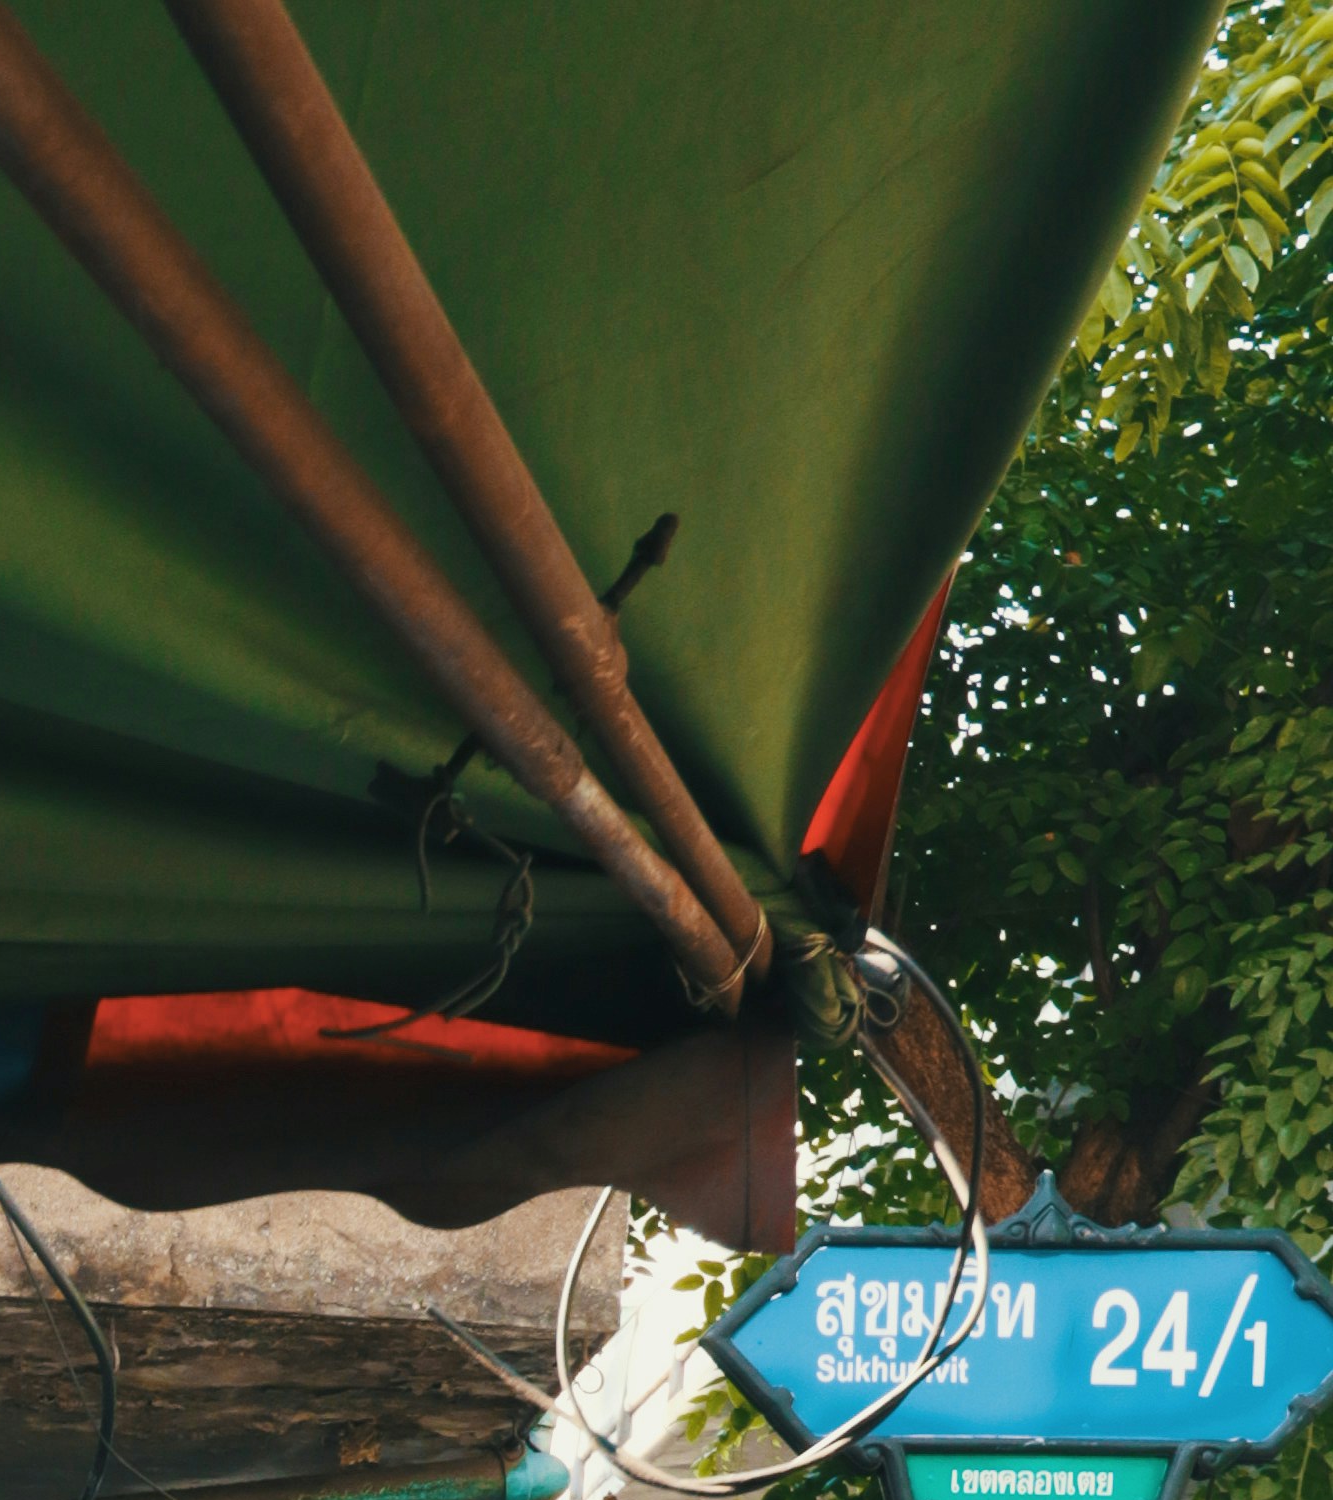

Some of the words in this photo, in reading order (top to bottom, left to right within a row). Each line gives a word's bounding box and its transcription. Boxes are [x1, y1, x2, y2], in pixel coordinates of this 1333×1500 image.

[816, 1258, 1036, 1357] สุขุมวิท
[1090, 1273, 1268, 1398] 24/1
[950, 1467, 1114, 1497] เขตคลองเตย
